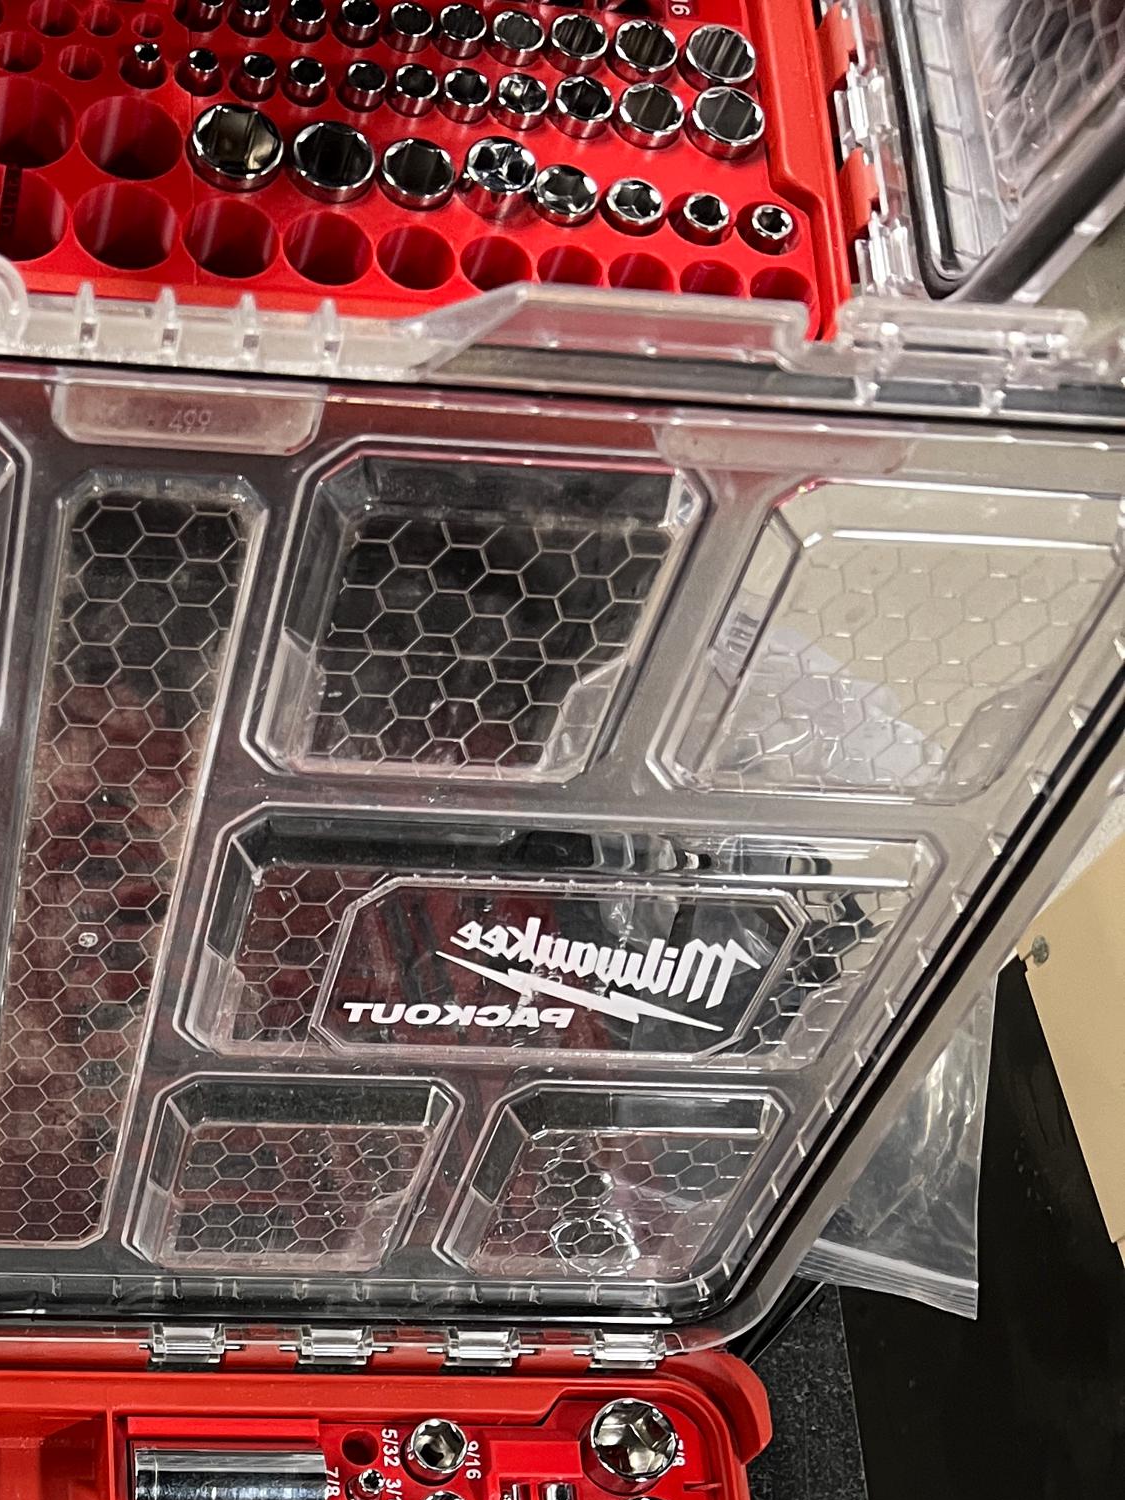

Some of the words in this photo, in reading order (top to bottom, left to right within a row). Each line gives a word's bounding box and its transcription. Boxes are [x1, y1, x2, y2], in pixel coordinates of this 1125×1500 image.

[381, 1428, 401, 1467] 5/32
[466, 1440, 482, 1480] 9/16
[326, 1467, 341, 1497] 7/8
